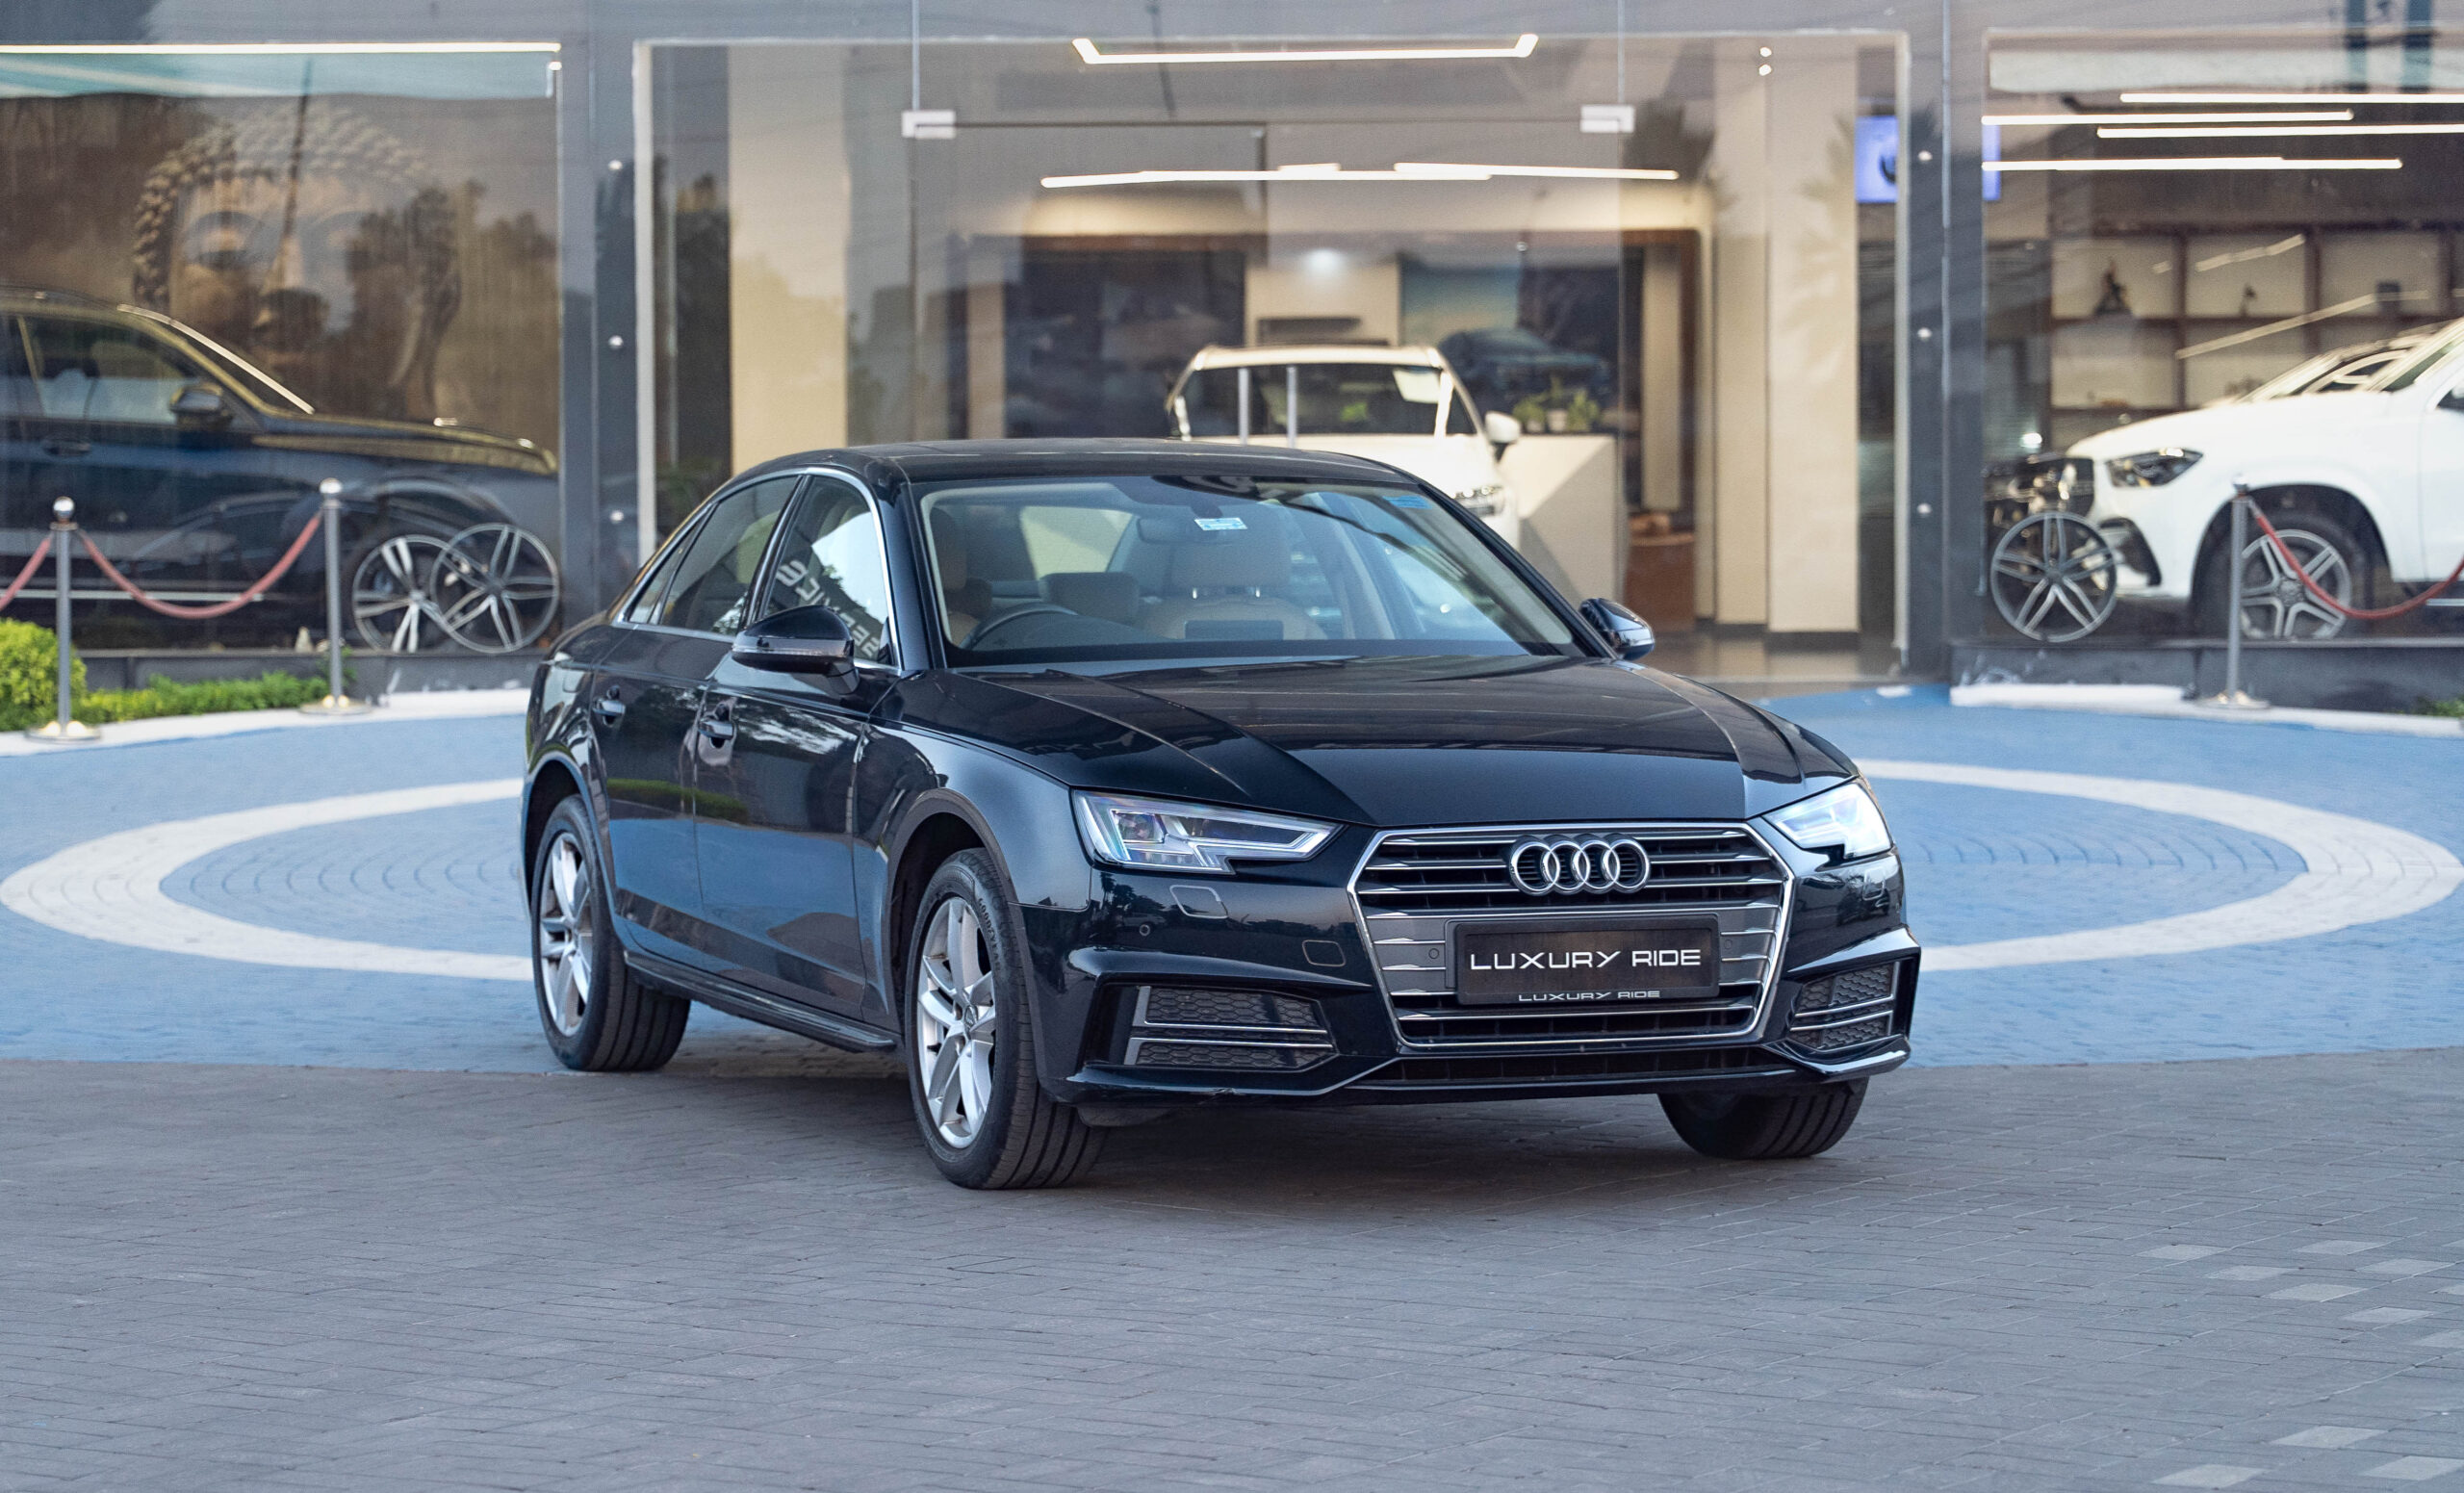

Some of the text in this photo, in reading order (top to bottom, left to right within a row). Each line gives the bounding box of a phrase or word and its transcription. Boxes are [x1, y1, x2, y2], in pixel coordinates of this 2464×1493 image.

[1471, 949, 1701, 969] LUXURY RIDE
[1519, 992, 1611, 1001] LUXURY
